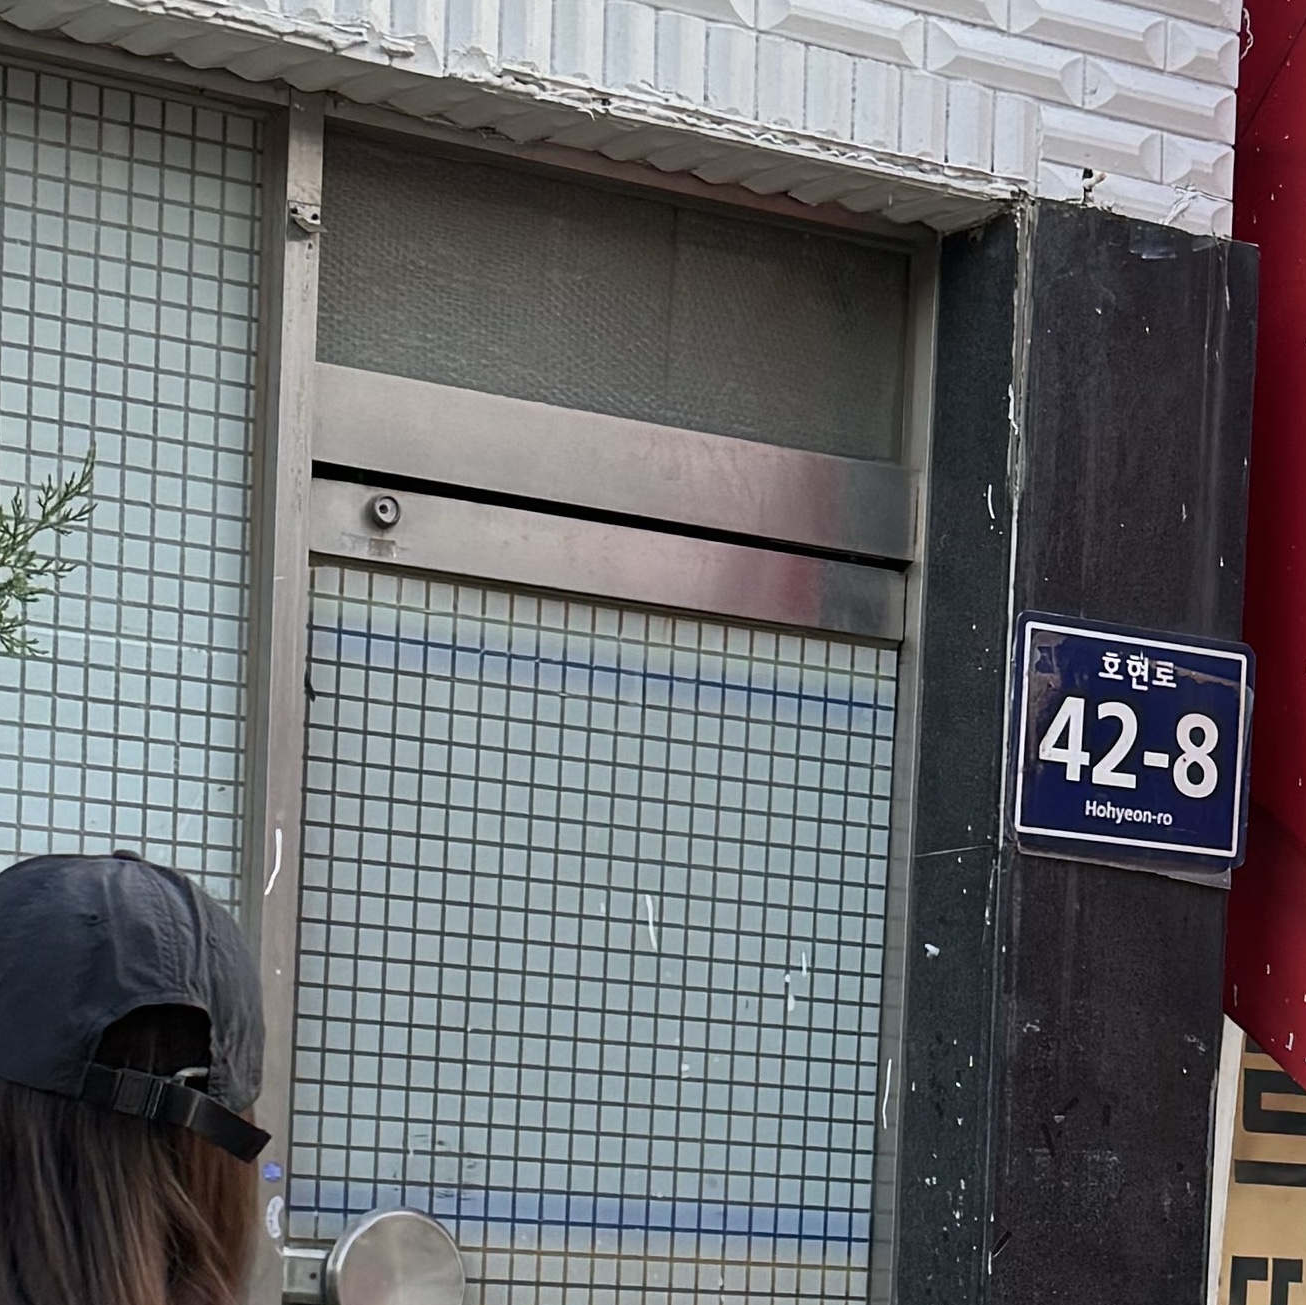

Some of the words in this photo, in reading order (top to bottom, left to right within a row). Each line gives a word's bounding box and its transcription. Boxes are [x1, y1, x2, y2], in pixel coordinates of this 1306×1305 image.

[1098, 651, 1177, 690] 호현로
[1039, 696, 1219, 798] 42-8
[1085, 800, 1173, 825] Hohyeon-ro
